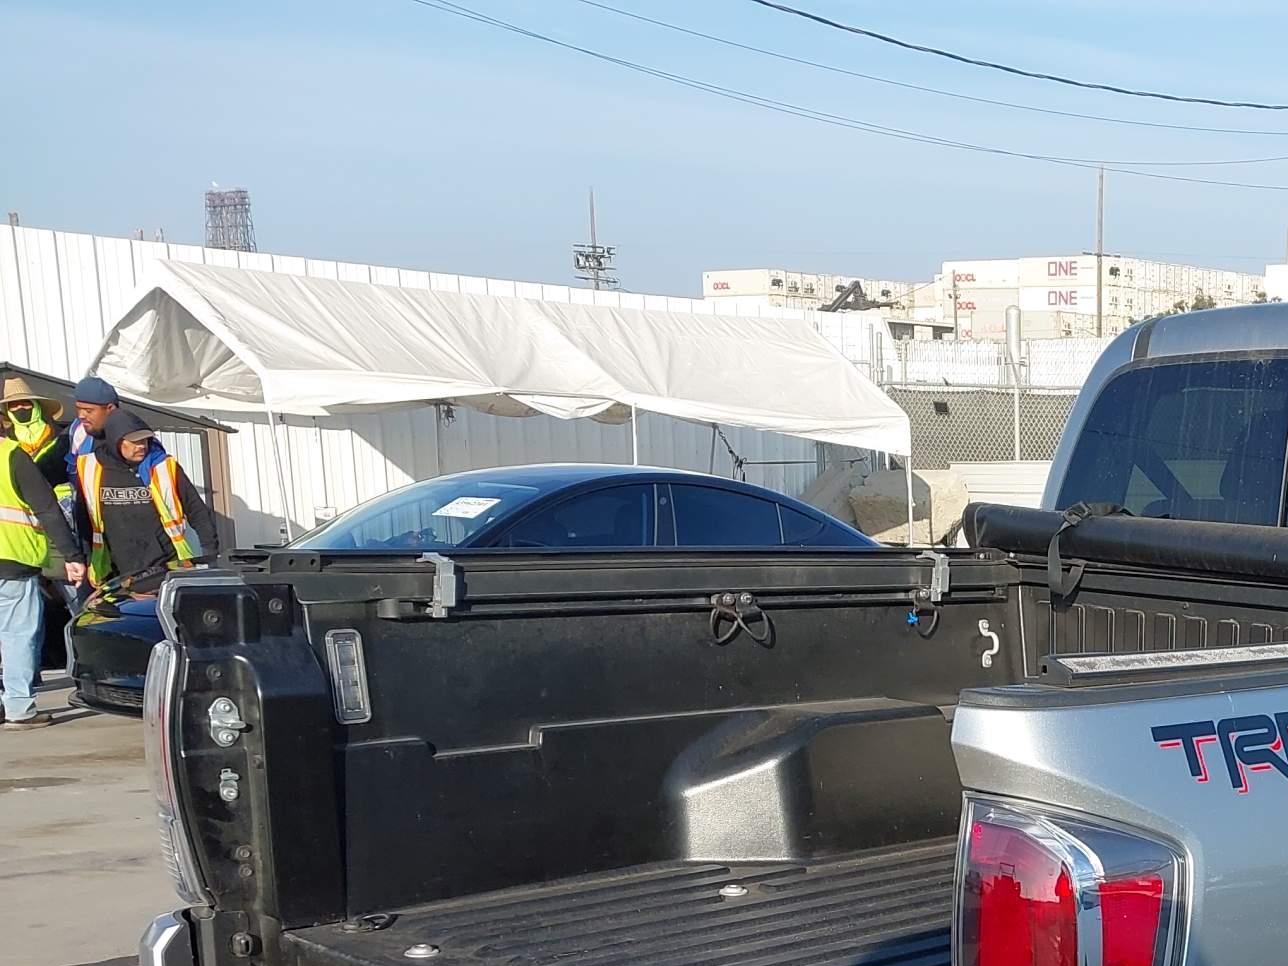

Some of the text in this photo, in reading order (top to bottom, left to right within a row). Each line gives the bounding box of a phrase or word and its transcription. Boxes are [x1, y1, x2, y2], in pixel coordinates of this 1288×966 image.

[1047, 260, 1078, 277] ONE
[1047, 290, 1078, 306] ONE
[102, 488, 152, 500] AERO
